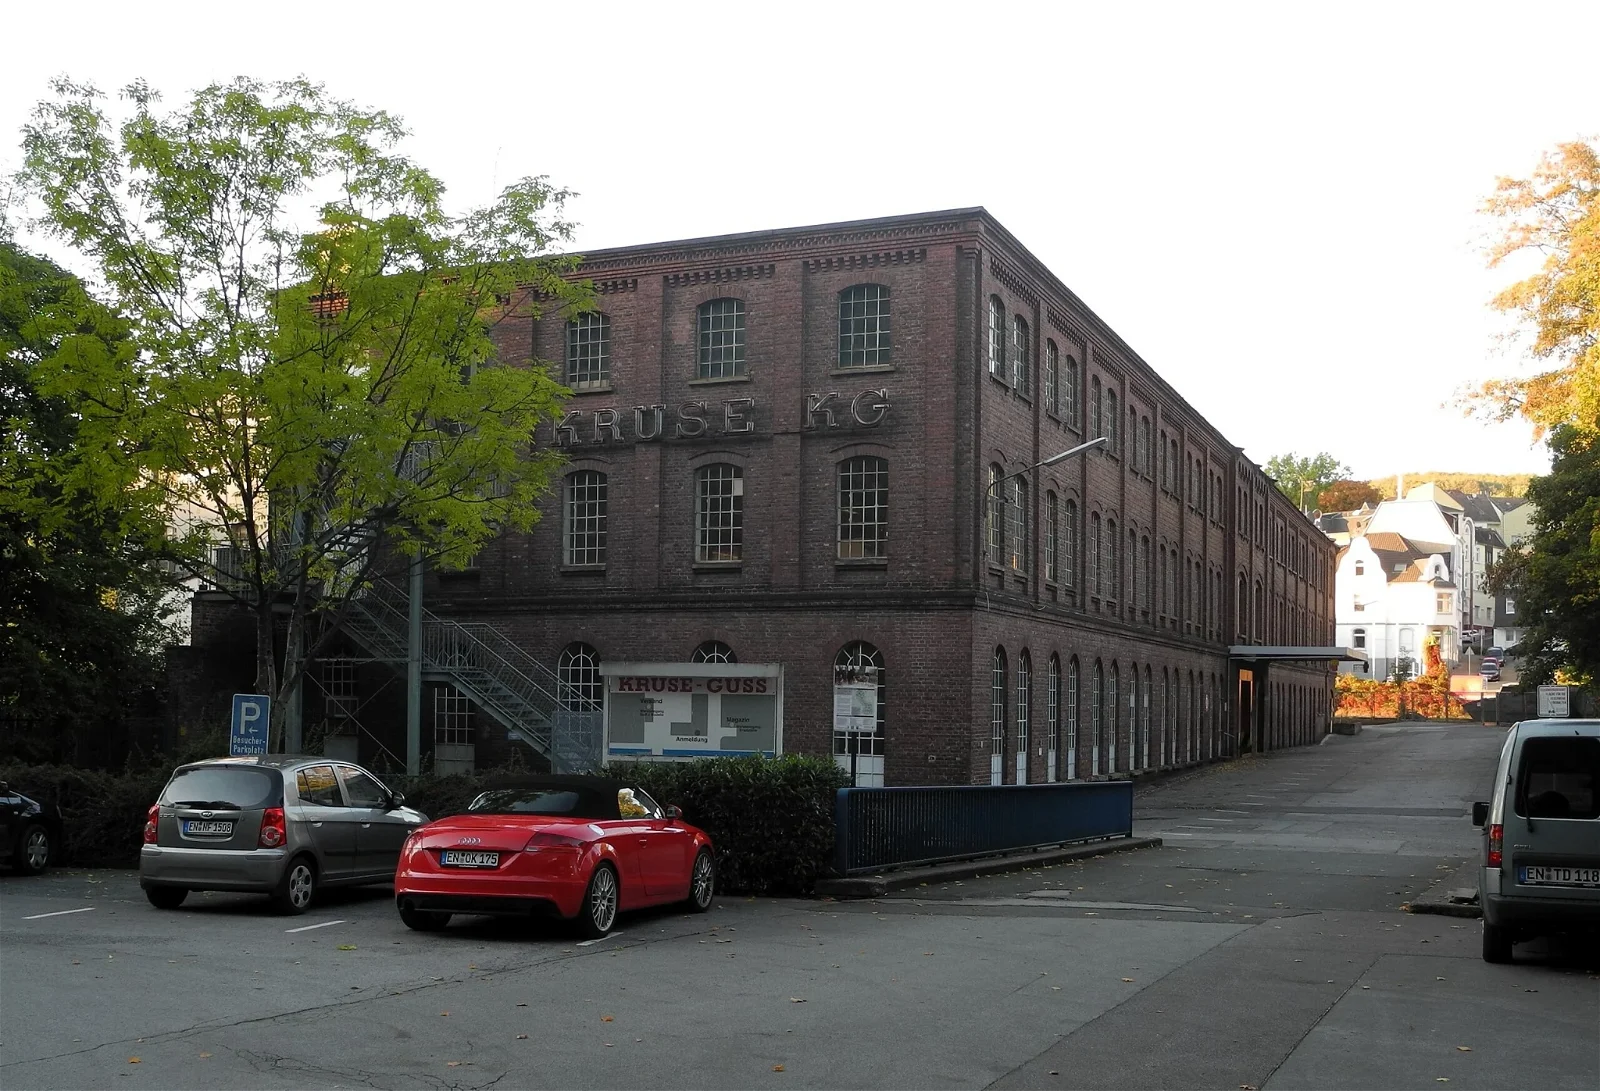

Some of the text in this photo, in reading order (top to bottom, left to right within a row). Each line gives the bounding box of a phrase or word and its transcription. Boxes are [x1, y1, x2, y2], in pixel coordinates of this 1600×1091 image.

[550, 388, 892, 446] KRUSE KG
[618, 677, 693, 692] KRUSE
[706, 678, 767, 693] GUSS
[240, 702, 261, 735] P
[233, 735, 266, 745] Besucher-
[233, 744, 264, 754] Parkplatz
[188, 822, 199, 831] EN
[203, 822, 212, 831] NF
[447, 852, 498, 864] EN OK 175
[1527, 868, 1600, 882] EN TD 118
